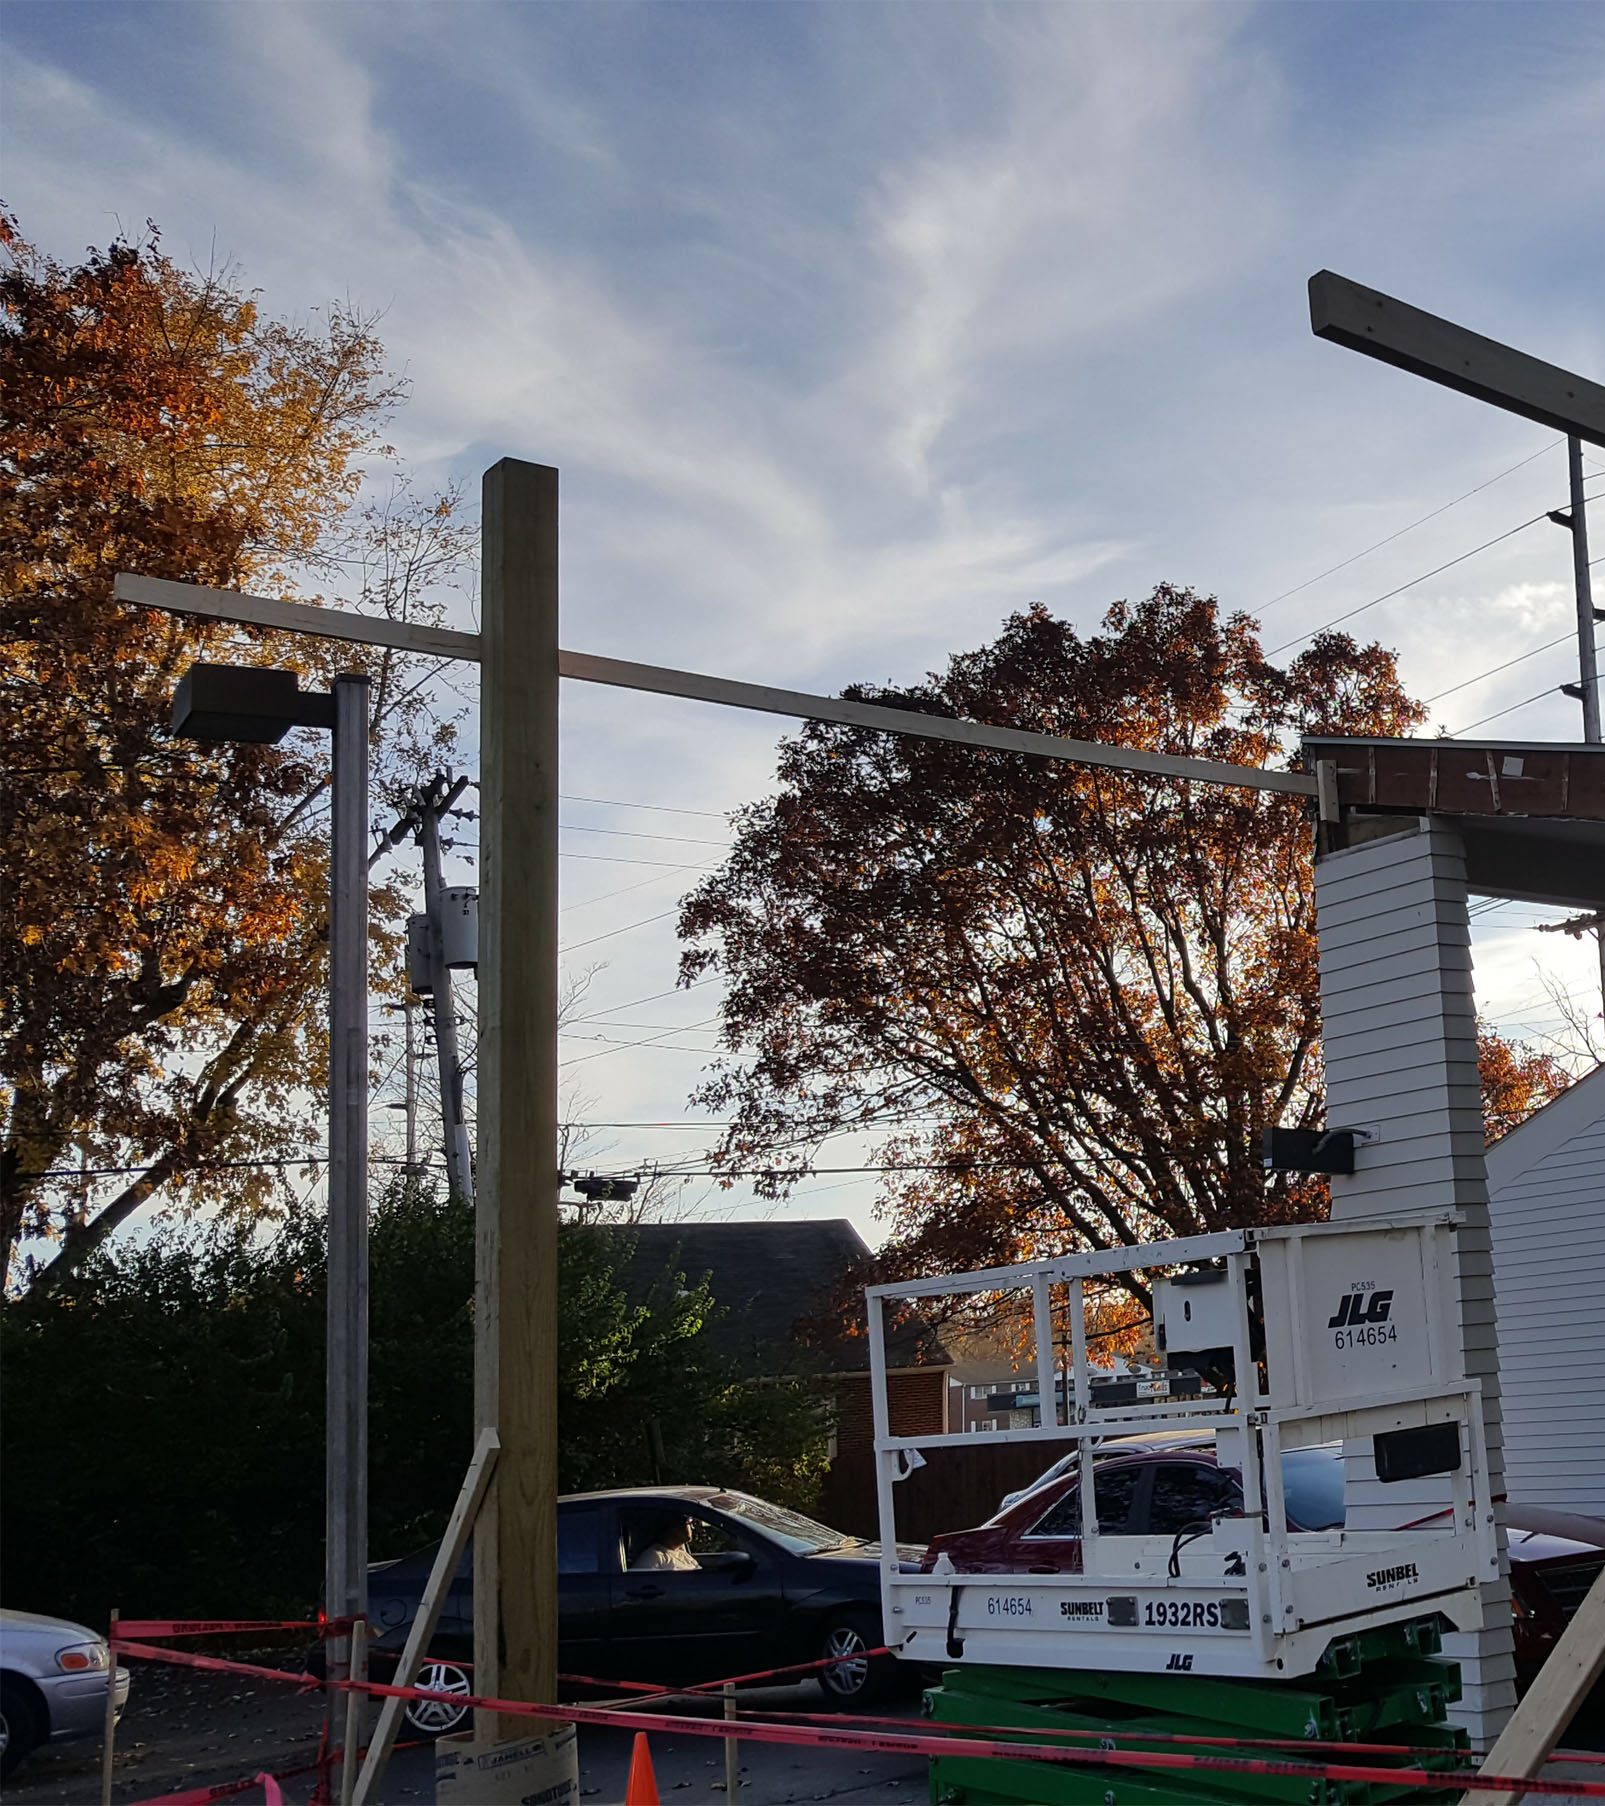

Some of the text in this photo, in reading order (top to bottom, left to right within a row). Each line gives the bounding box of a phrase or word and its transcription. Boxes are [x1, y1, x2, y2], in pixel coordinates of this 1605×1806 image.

[1351, 1281, 1376, 1292] PC535
[1328, 1290, 1394, 1328] JLG
[1335, 1325, 1397, 1349] 614654
[987, 1597, 1032, 1615] 614654
[1060, 1602, 1104, 1615] SUNBELT
[1145, 1601, 1220, 1627] 1932RS
[1166, 1653, 1194, 1671] JLG
